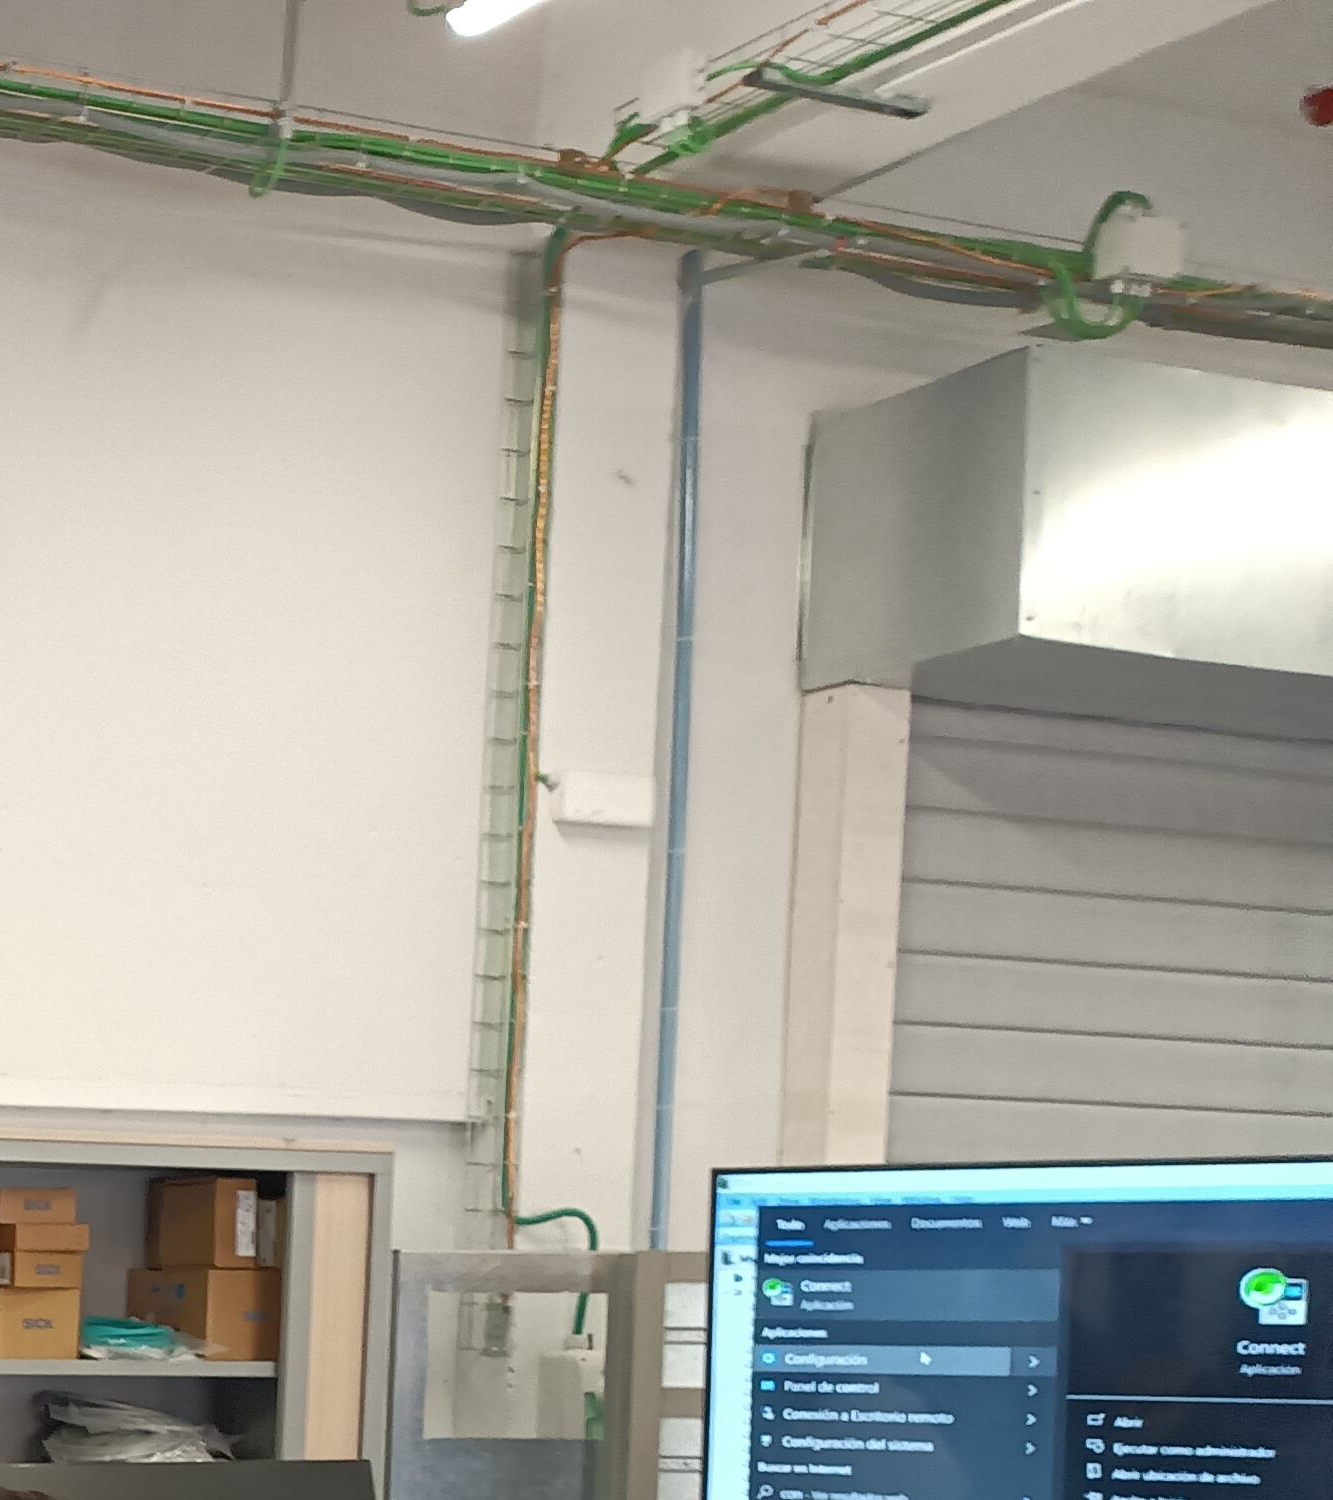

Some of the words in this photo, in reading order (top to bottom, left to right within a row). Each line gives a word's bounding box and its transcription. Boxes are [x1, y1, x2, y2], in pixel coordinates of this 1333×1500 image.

[800, 1279, 852, 1293] Connect
[1236, 1339, 1307, 1356] Connect
[785, 1352, 868, 1368] Configuración
[1239, 1363, 1302, 1377] Aplicación
[784, 1380, 816, 1393] Panel
[818, 1381, 834, 1393] de
[836, 1382, 879, 1394] control
[783, 1407, 838, 1422] Conexión
[851, 1409, 906, 1424] Escritorio
[908, 1413, 955, 1424] remoto
[781, 1435, 865, 1451] Configuración
[866, 1437, 886, 1450] del
[888, 1438, 934, 1452] sistema
